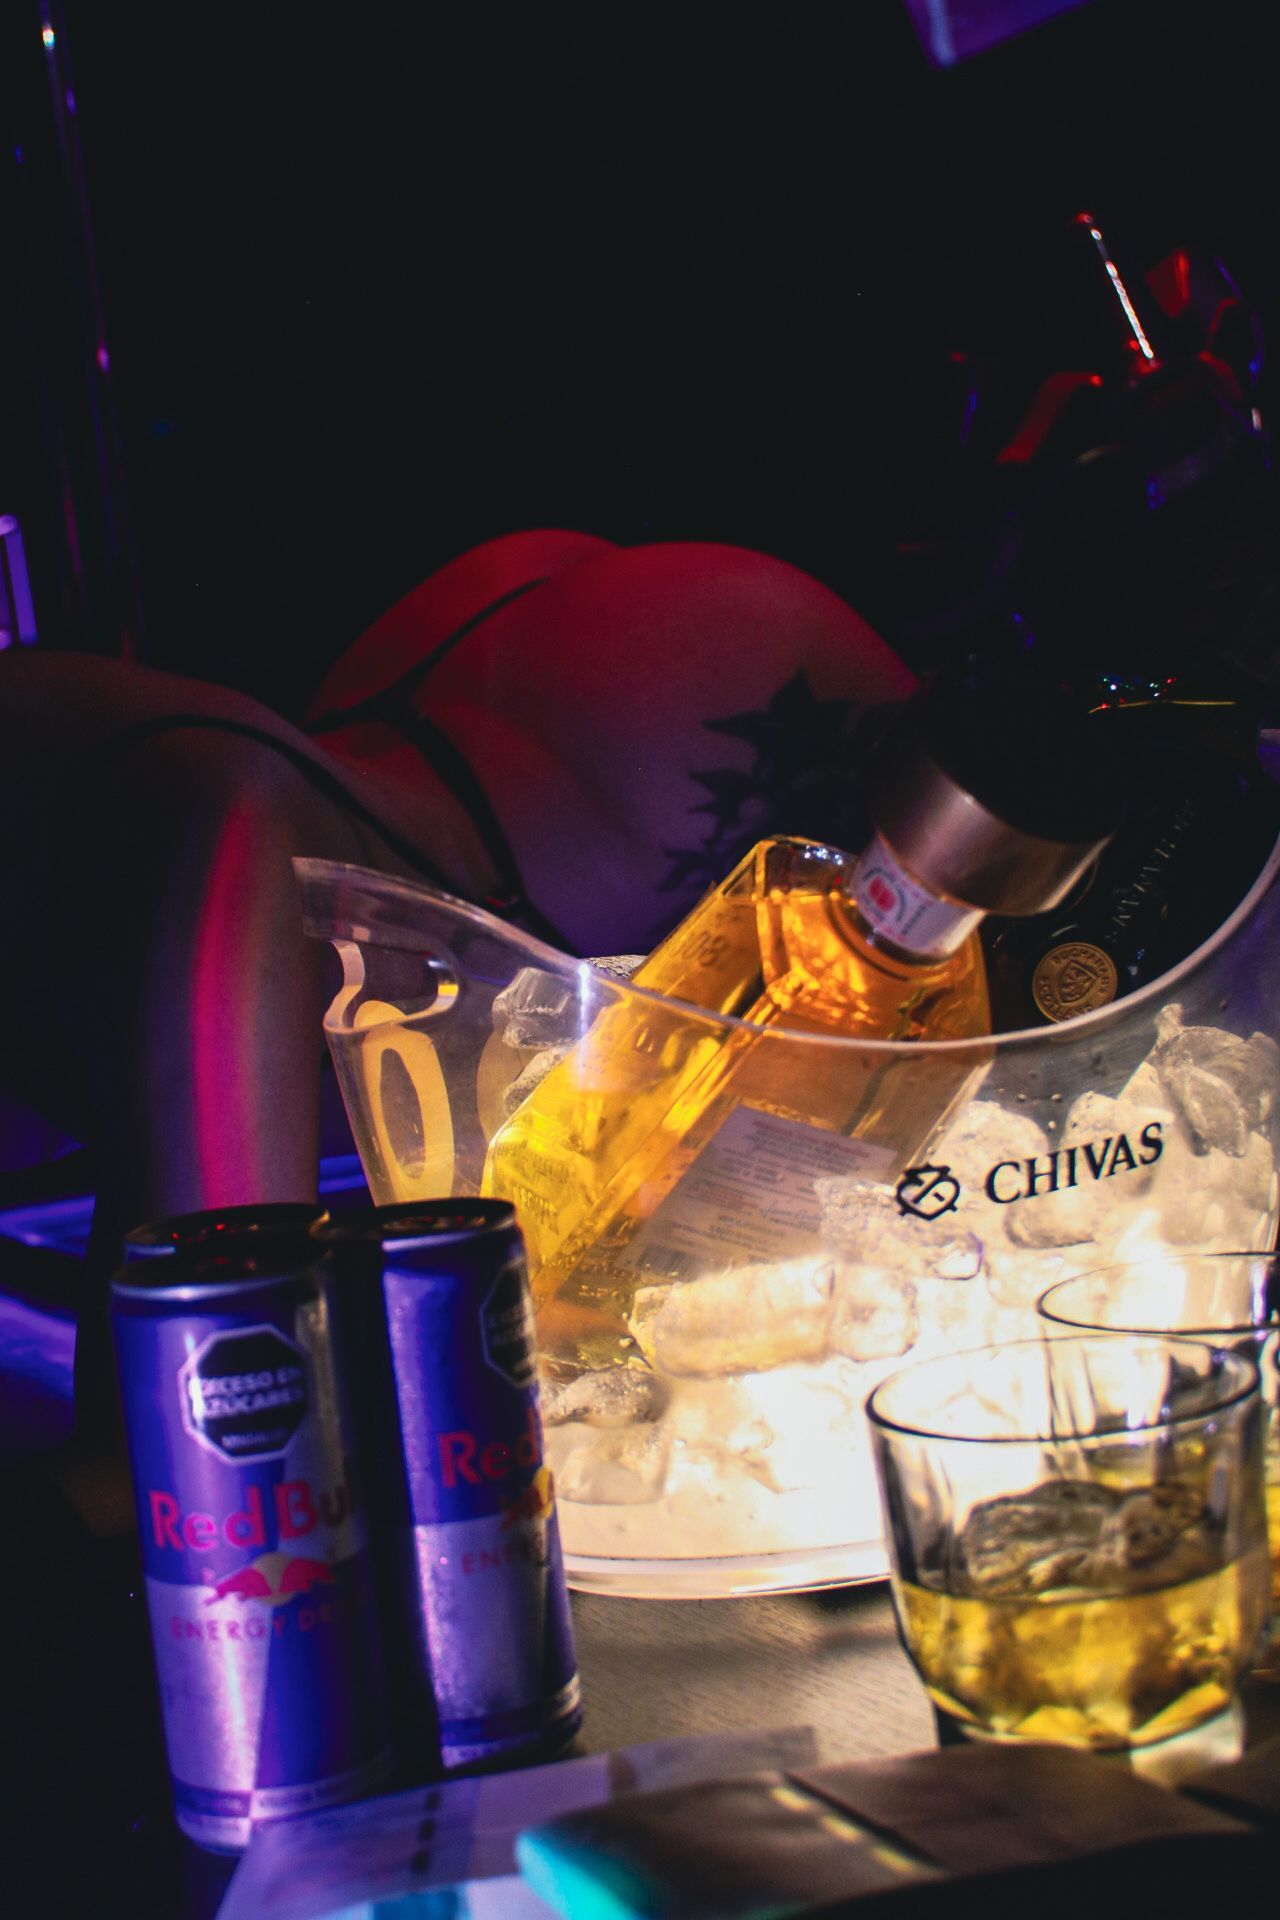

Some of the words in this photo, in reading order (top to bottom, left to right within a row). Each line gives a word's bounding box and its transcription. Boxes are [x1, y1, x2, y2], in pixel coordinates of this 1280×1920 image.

[984, 1121, 1164, 1204] CHIVAS
[437, 1407, 540, 1489] Red
[150, 1485, 266, 1552] Red
[274, 1478, 349, 1541] Bu
[170, 1614, 286, 1642] ENERGY
